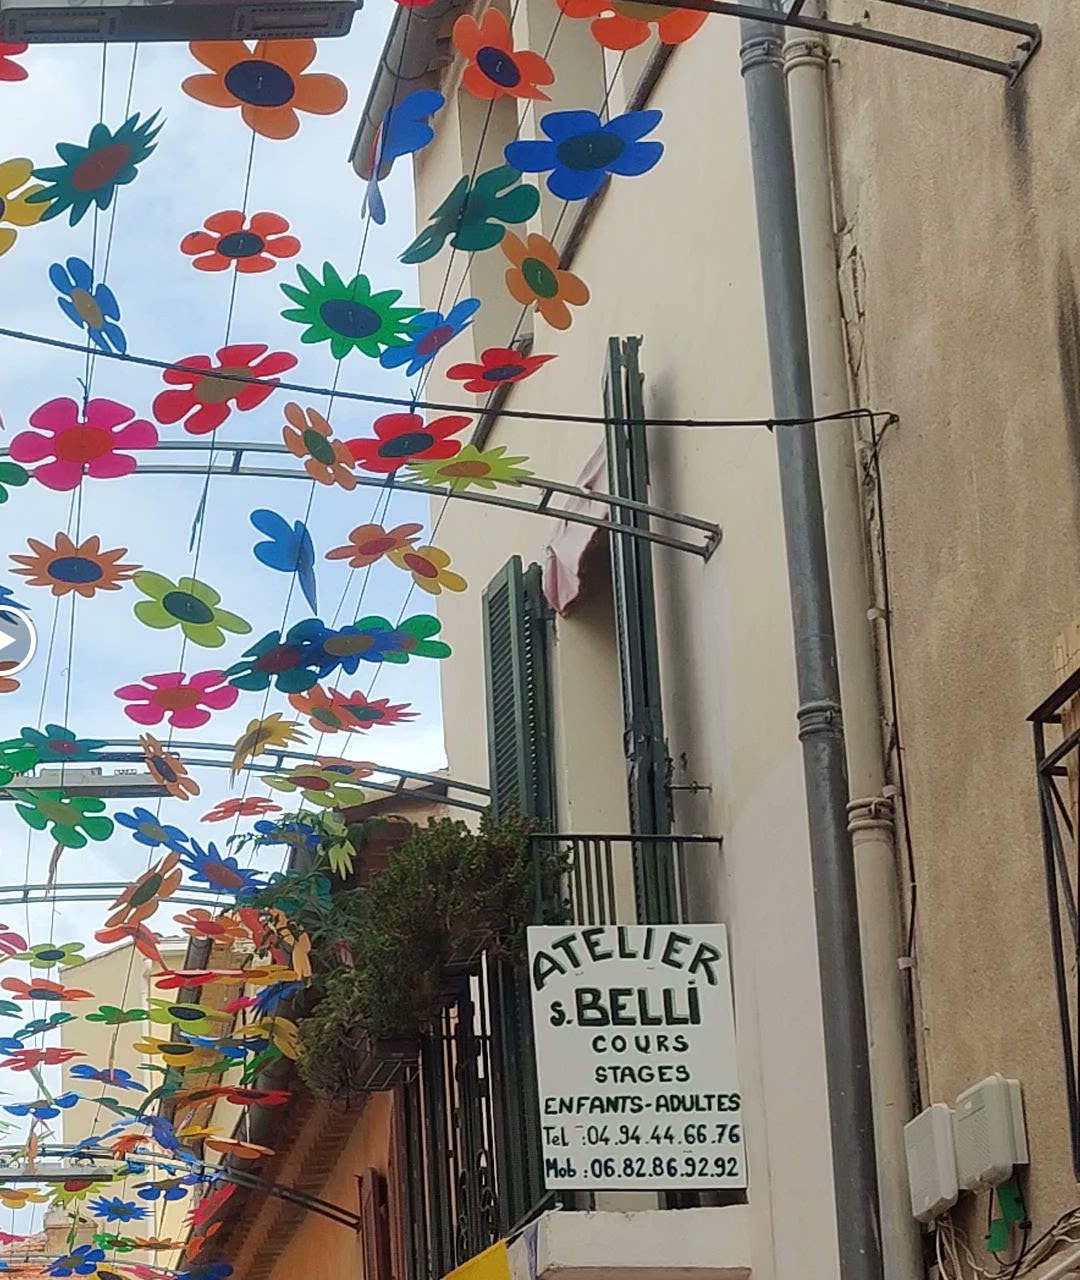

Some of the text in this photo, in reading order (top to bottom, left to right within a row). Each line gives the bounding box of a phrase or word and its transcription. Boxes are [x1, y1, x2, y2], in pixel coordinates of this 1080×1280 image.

[532, 926, 721, 991] ATELIER
[592, 1035, 689, 1053] COURS
[595, 1065, 690, 1083] STAGES
[545, 1158, 577, 1179] Mob
